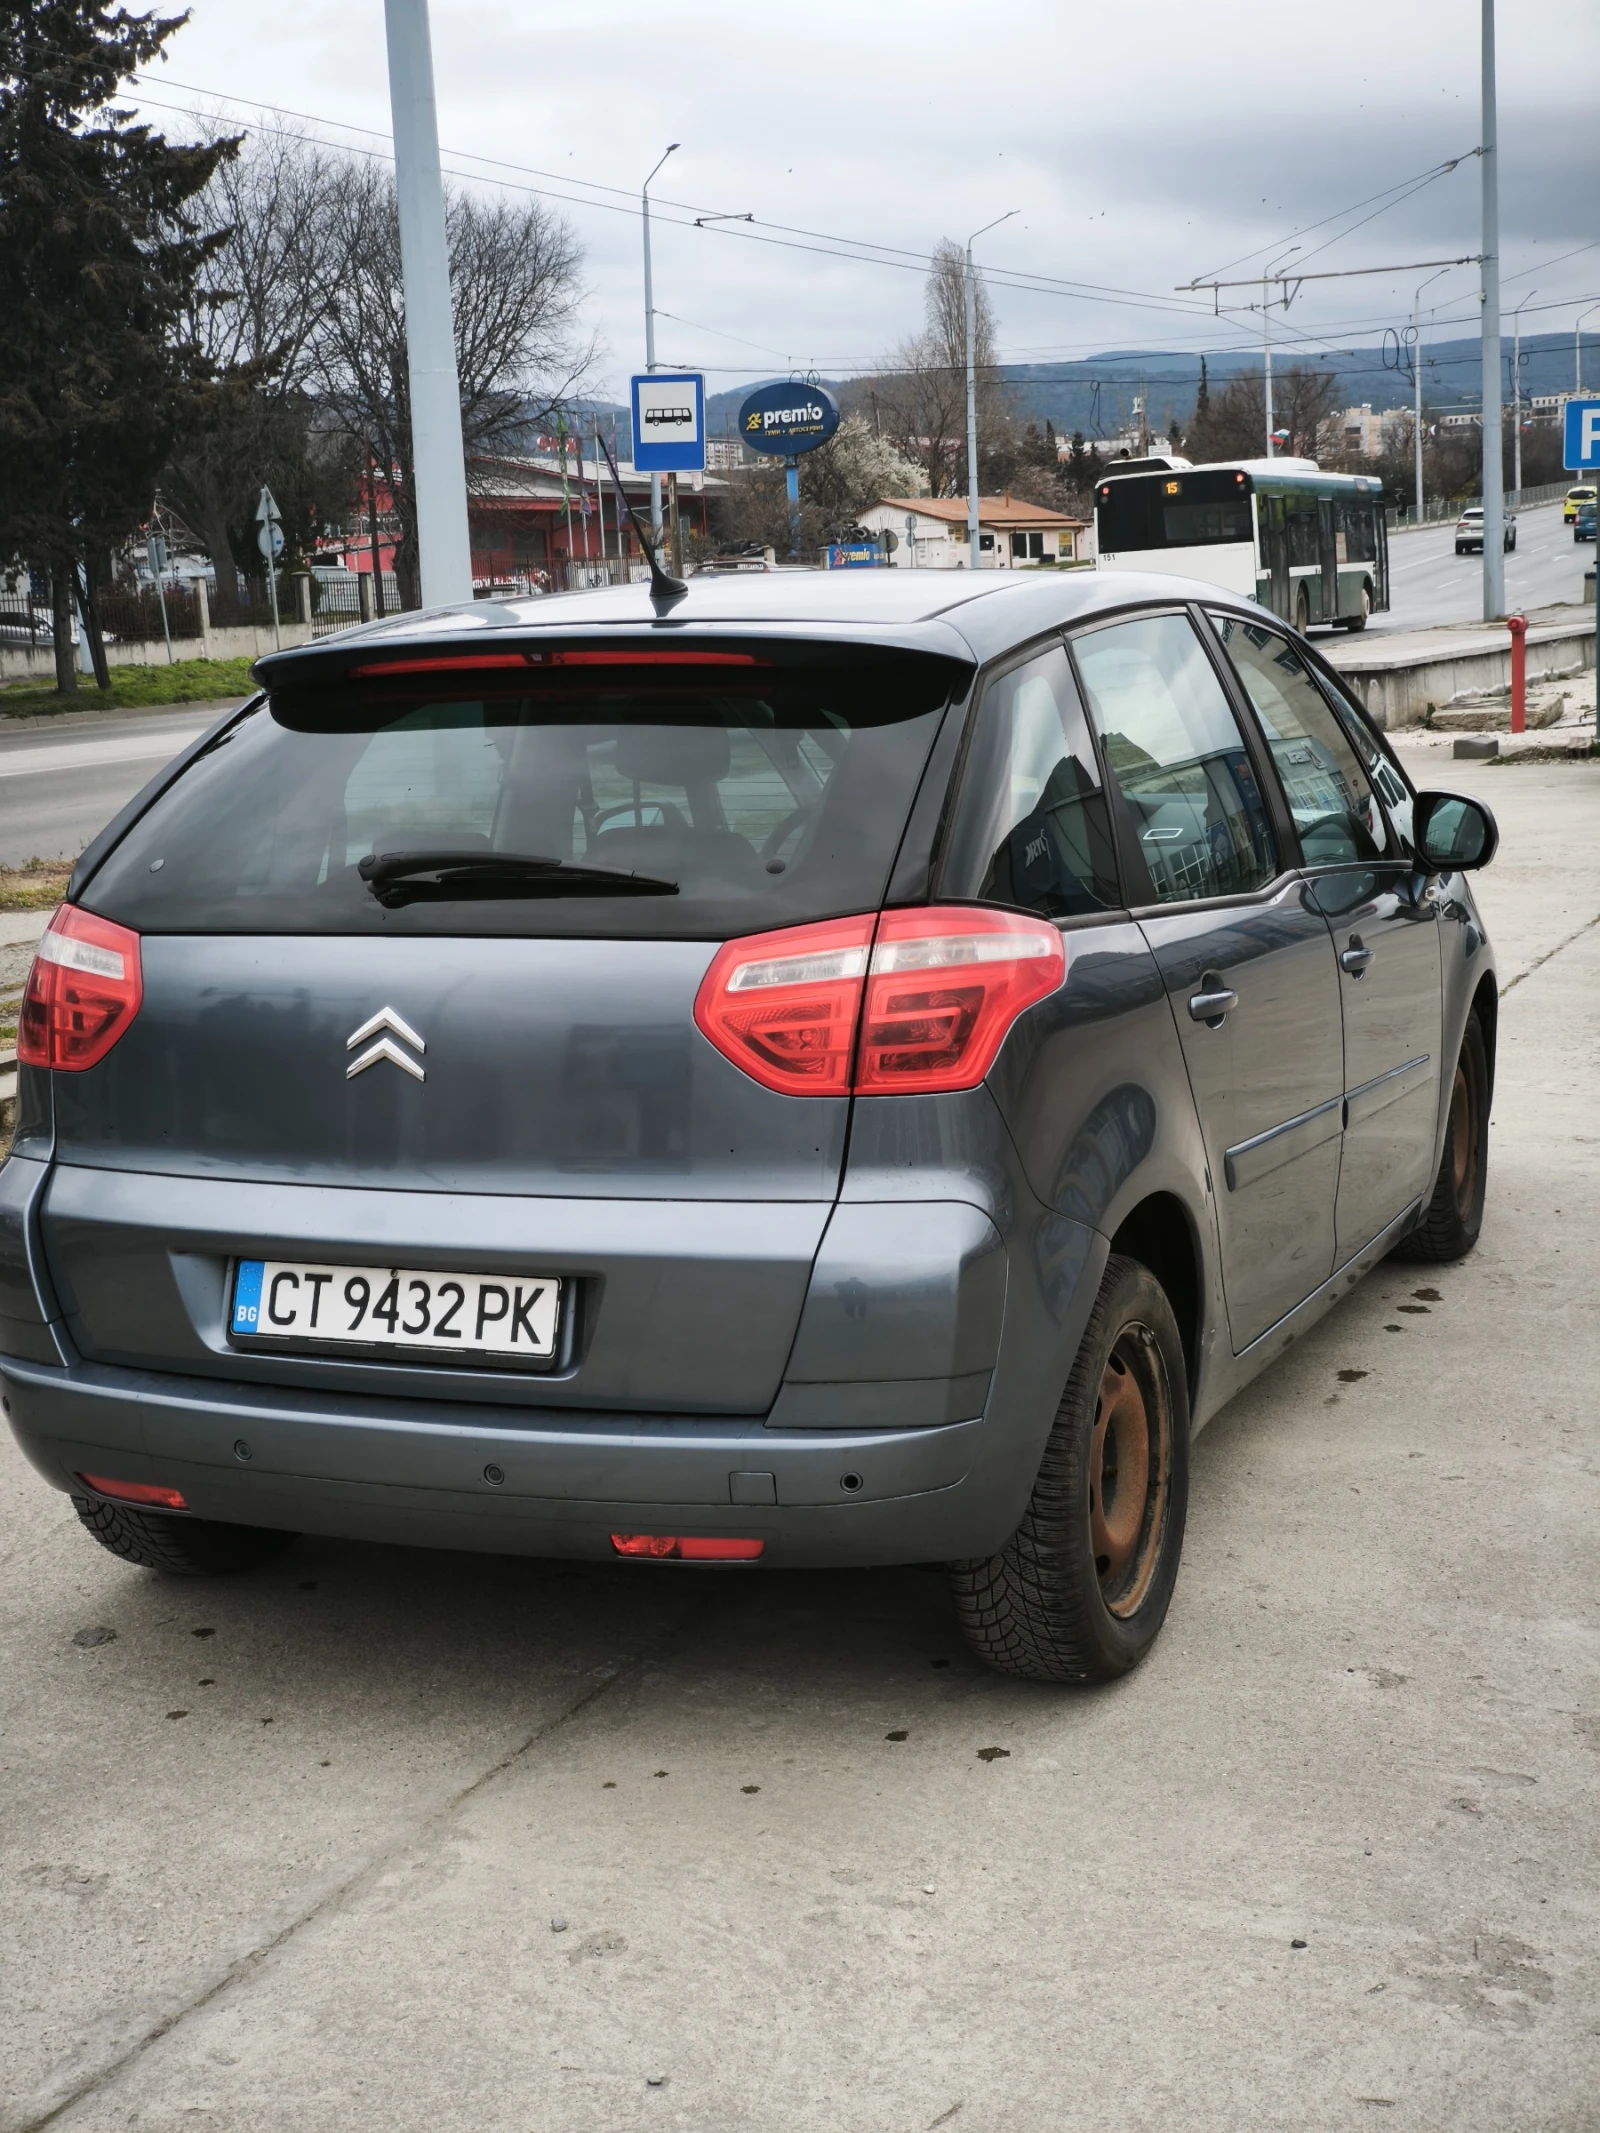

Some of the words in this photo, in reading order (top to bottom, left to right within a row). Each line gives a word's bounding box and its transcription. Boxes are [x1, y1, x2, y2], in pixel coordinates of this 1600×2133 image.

[763, 402, 823, 429] premio
[1165, 482, 1178, 494] 15
[1103, 553, 1116, 562] 151
[236, 1304, 257, 1323] BG
[268, 1271, 333, 1328] CT
[343, 1276, 465, 1338] 9432
[475, 1284, 545, 1345] PK
